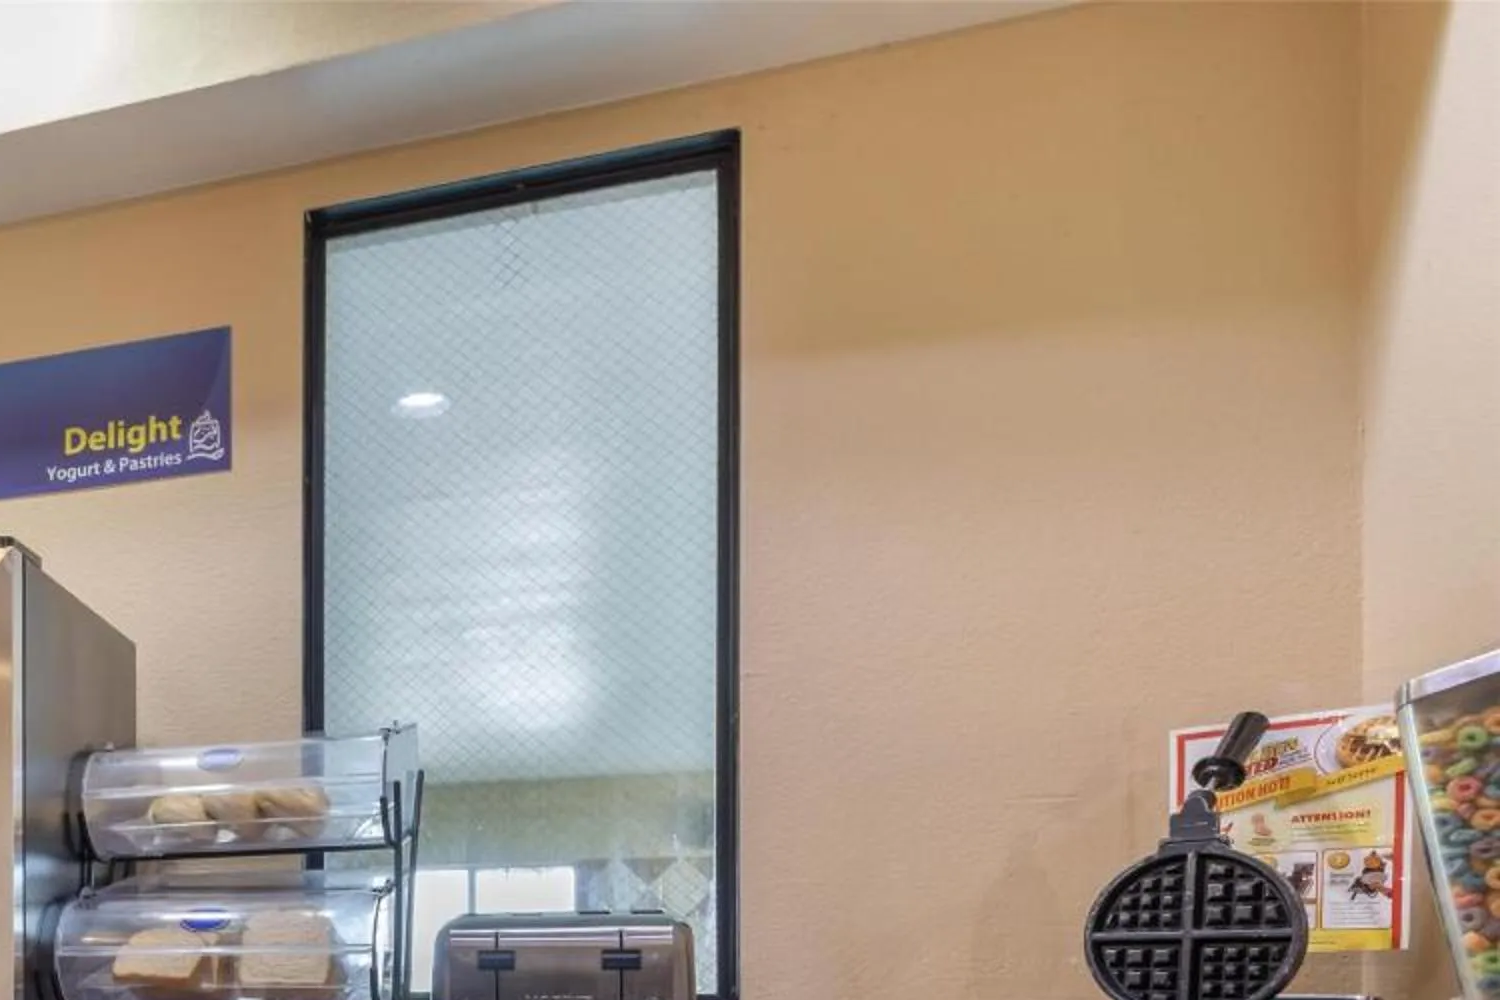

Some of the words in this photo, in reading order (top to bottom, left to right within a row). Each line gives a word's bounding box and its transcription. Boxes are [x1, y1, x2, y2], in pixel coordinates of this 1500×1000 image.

[63, 414, 183, 456] Delight
[46, 463, 101, 483] Yogurt
[103, 459, 117, 475] &
[118, 451, 183, 473] Pastries
